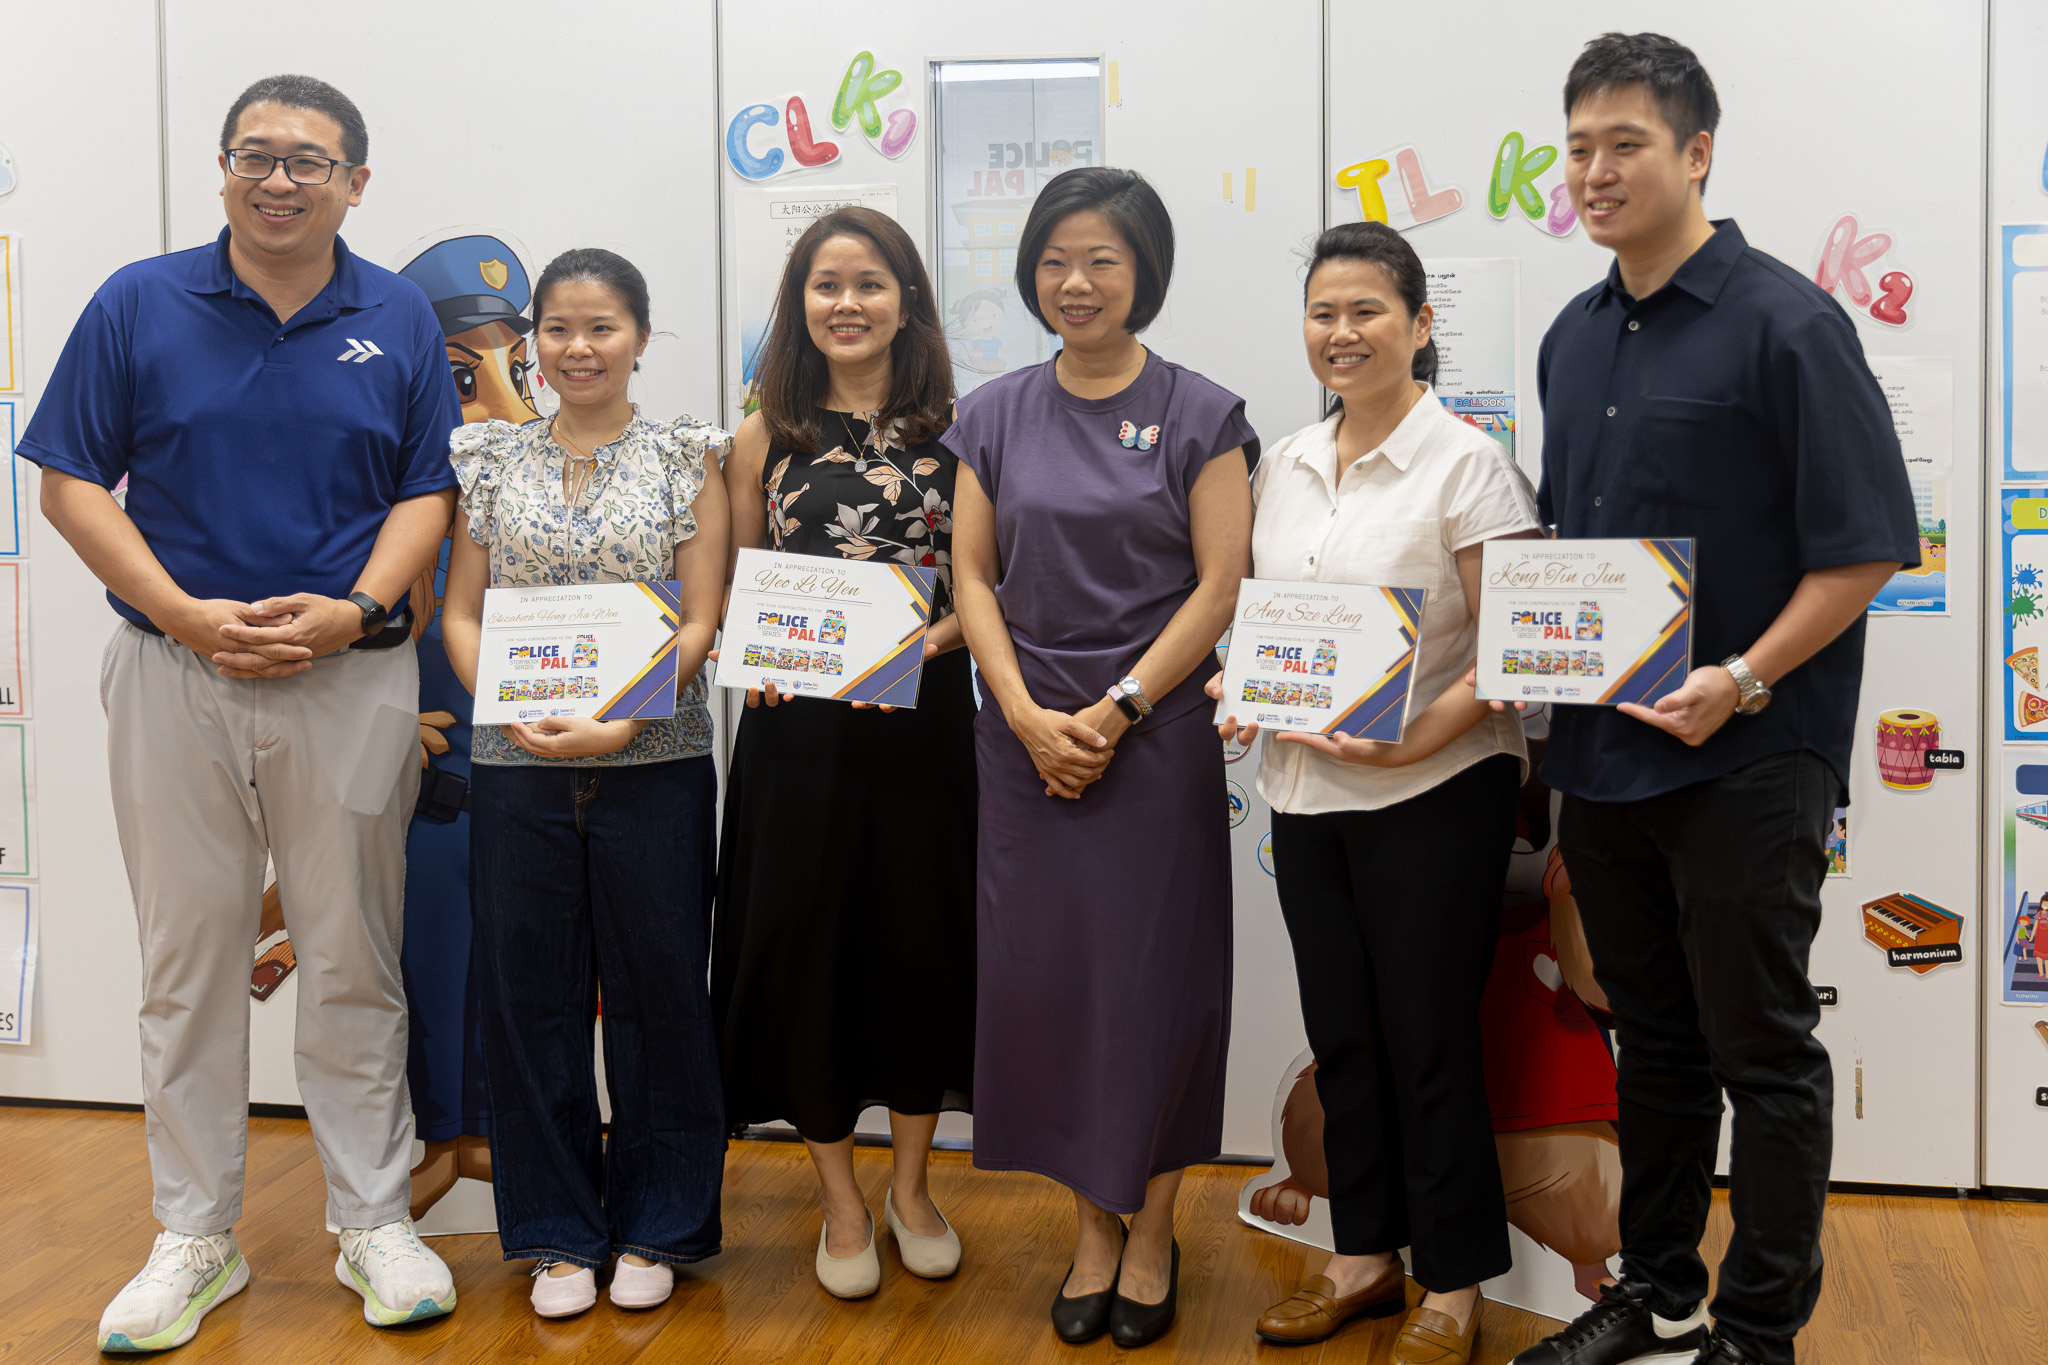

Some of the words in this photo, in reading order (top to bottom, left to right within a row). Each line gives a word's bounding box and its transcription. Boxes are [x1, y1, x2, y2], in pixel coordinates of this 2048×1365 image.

[726, 95, 839, 180] CL
[1336, 148, 1463, 226] TL
[1814, 215, 1913, 325] K2
[1455, 398, 1505, 407] BALLOON
[785, 564, 834, 574] APPRECIATION
[1490, 561, 1540, 589] Kong
[1544, 562, 1578, 586] Tin
[1582, 562, 1626, 587] Jun
[755, 569, 790, 592] Yeo
[793, 574, 818, 594] Li
[821, 576, 860, 599] Yen
[1283, 593, 1328, 601] APPRECIATION
[487, 611, 536, 624] Elizabeth
[537, 609, 567, 622] Heng
[568, 608, 590, 620] Jia
[592, 608, 619, 620] Wen
[1244, 600, 1285, 623] Ang
[1287, 603, 1320, 622] Sze
[1323, 604, 1363, 628] Ling
[788, 628, 816, 642] PAL
[1544, 626, 1572, 640] PAL
[541, 656, 568, 669] PAL
[1283, 660, 1308, 673] PAL
[1929, 754, 1960, 764] tabla
[1892, 949, 1957, 960] harmonium
